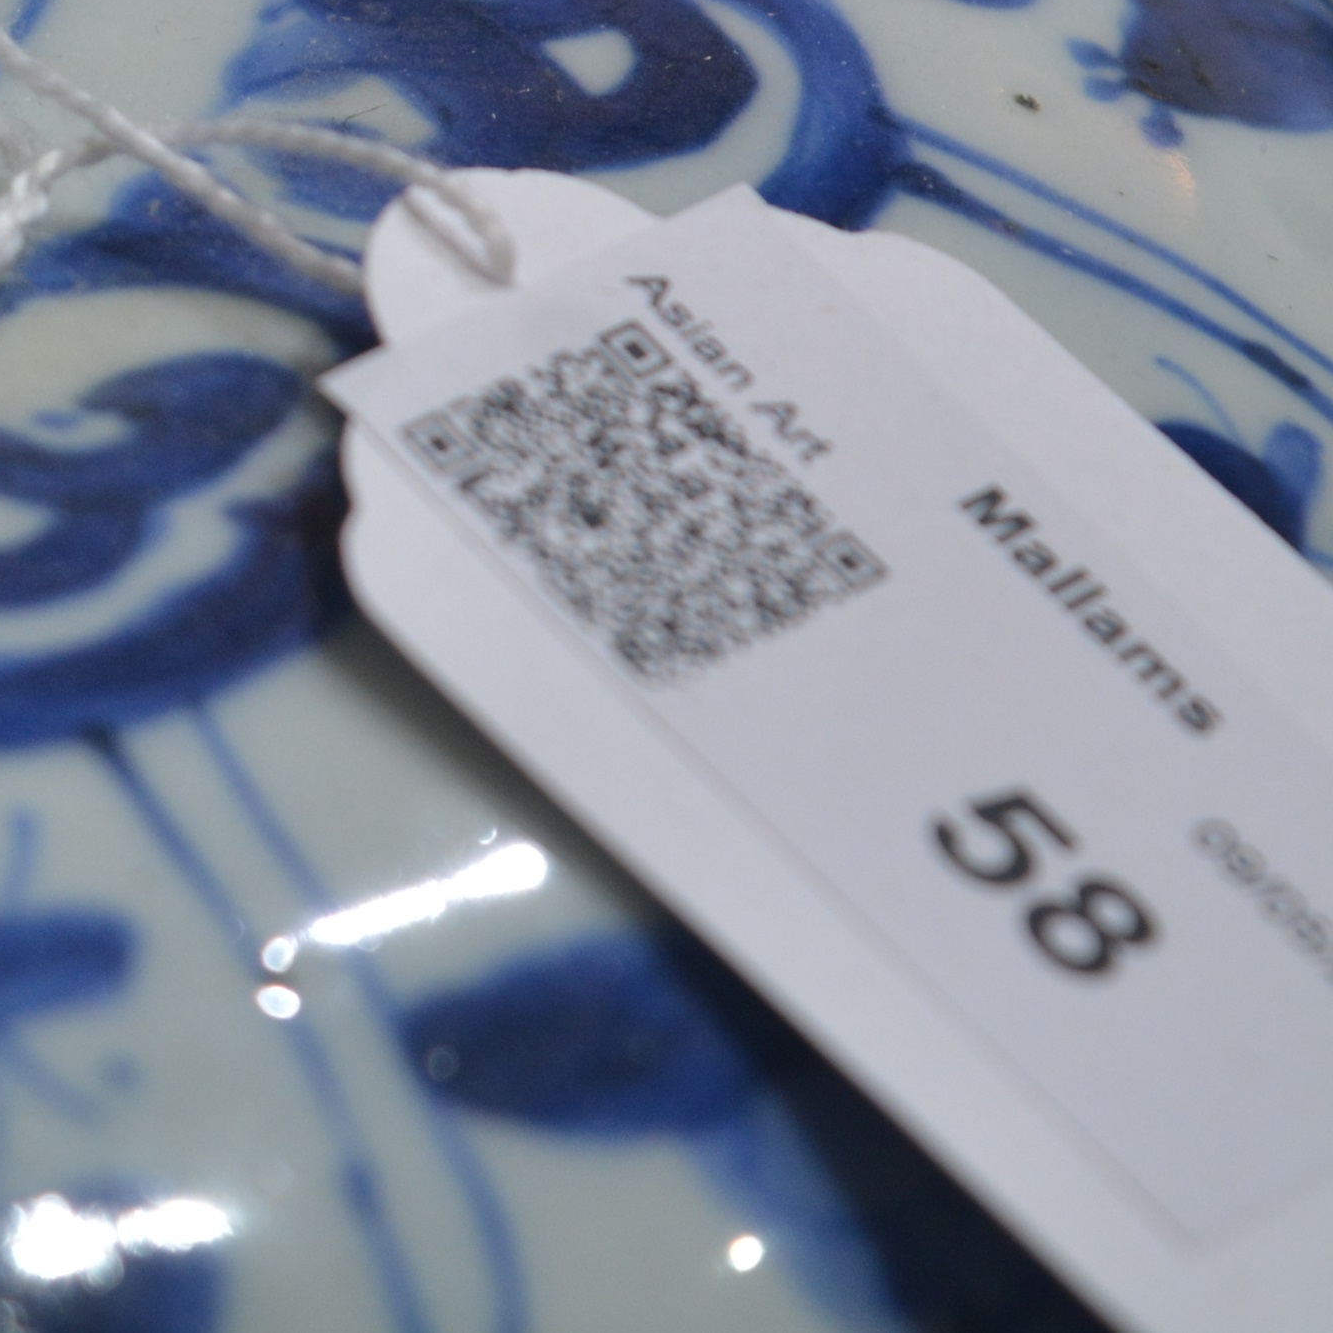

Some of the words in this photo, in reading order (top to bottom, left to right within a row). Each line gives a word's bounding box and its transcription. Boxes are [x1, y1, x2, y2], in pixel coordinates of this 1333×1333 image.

[624, 274, 756, 393] Asian
[748, 400, 835, 464] Art
[957, 483, 1221, 738] Mallams
[927, 785, 1163, 984] 58
